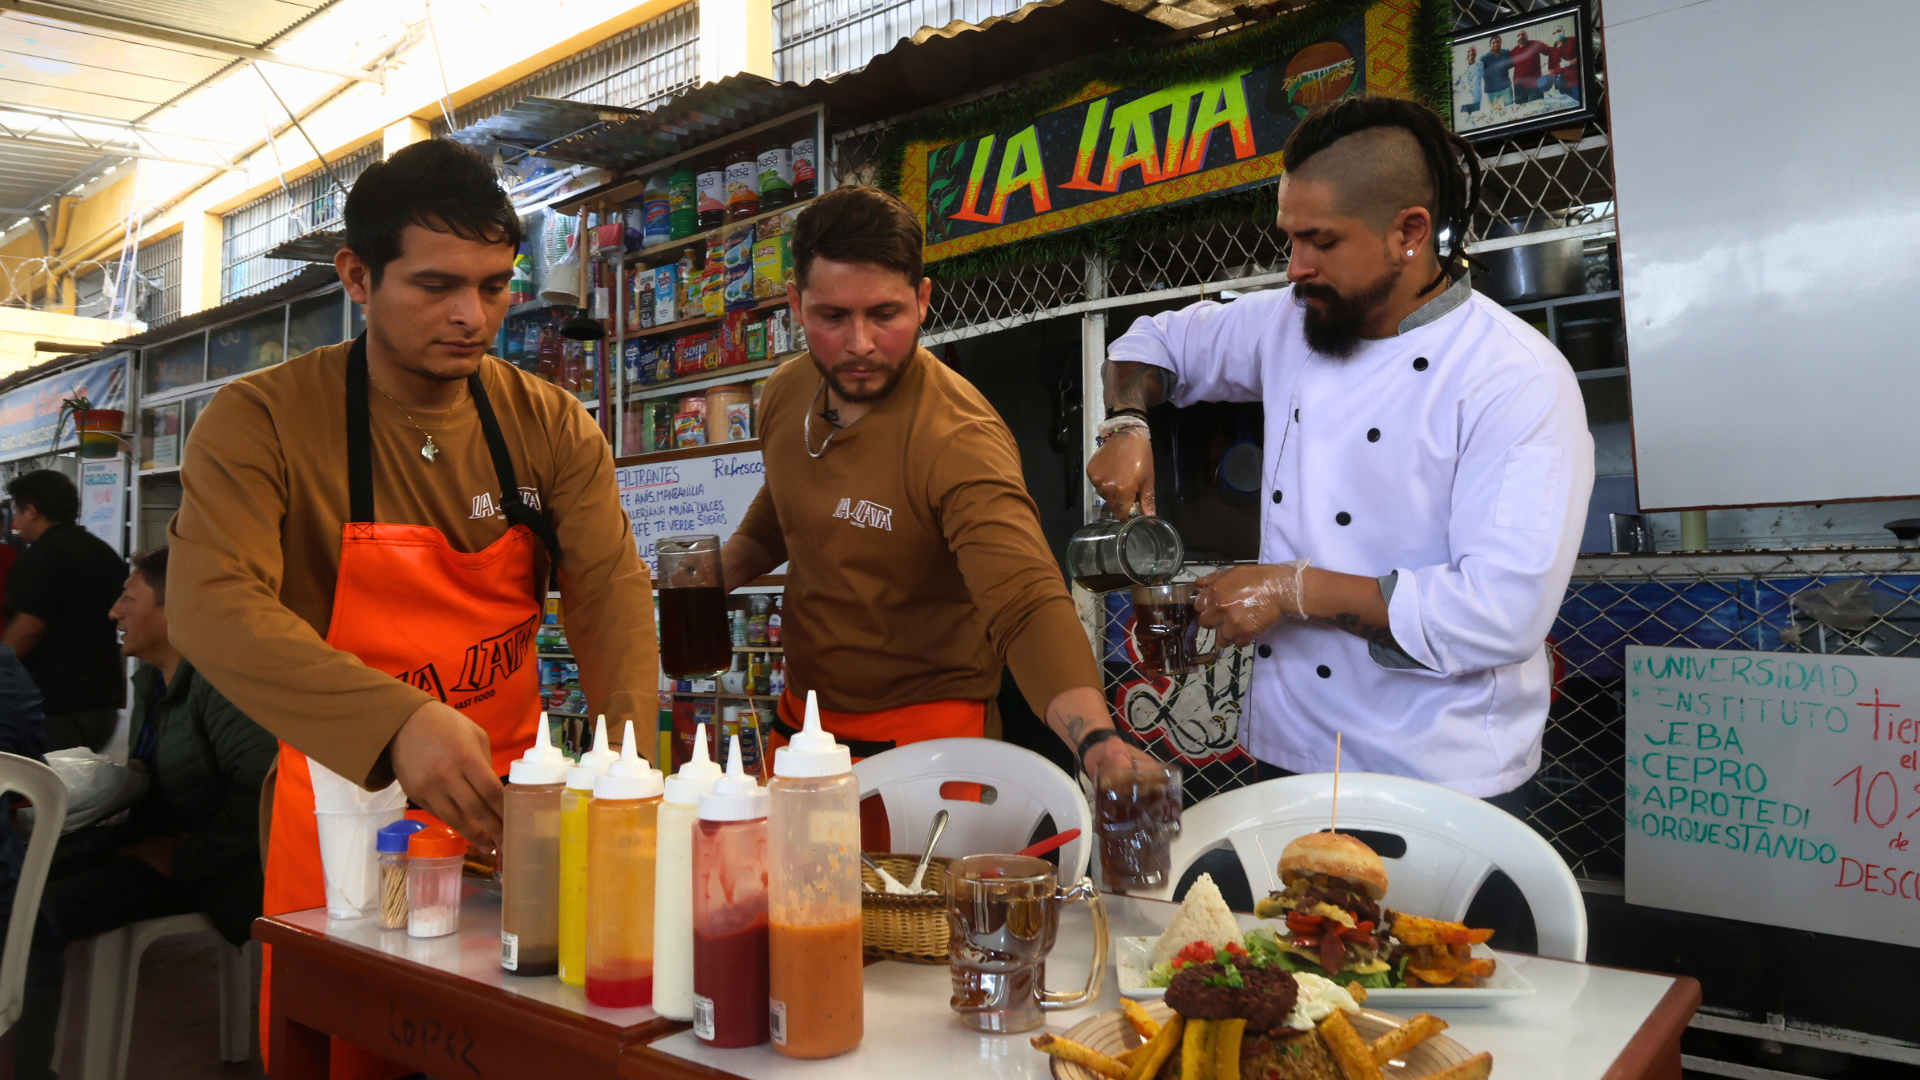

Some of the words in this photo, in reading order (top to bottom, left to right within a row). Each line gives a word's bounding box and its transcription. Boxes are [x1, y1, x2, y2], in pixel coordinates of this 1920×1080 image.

[947, 124, 1052, 224] LA
[1056, 68, 1257, 193] LATA
[683, 342, 708, 359] SODA
[468, 492, 495, 519] LA
[1647, 654, 1858, 697] UNIVERSIDAD
[454, 697, 473, 710] FAST
[473, 689, 496, 704] FOOD
[1641, 752, 1767, 793] CEPRO
[1900, 750, 1917, 771] el
[1642, 785, 1810, 829] APROTEDI
[1641, 813, 1837, 865] ORQUESTANDO
